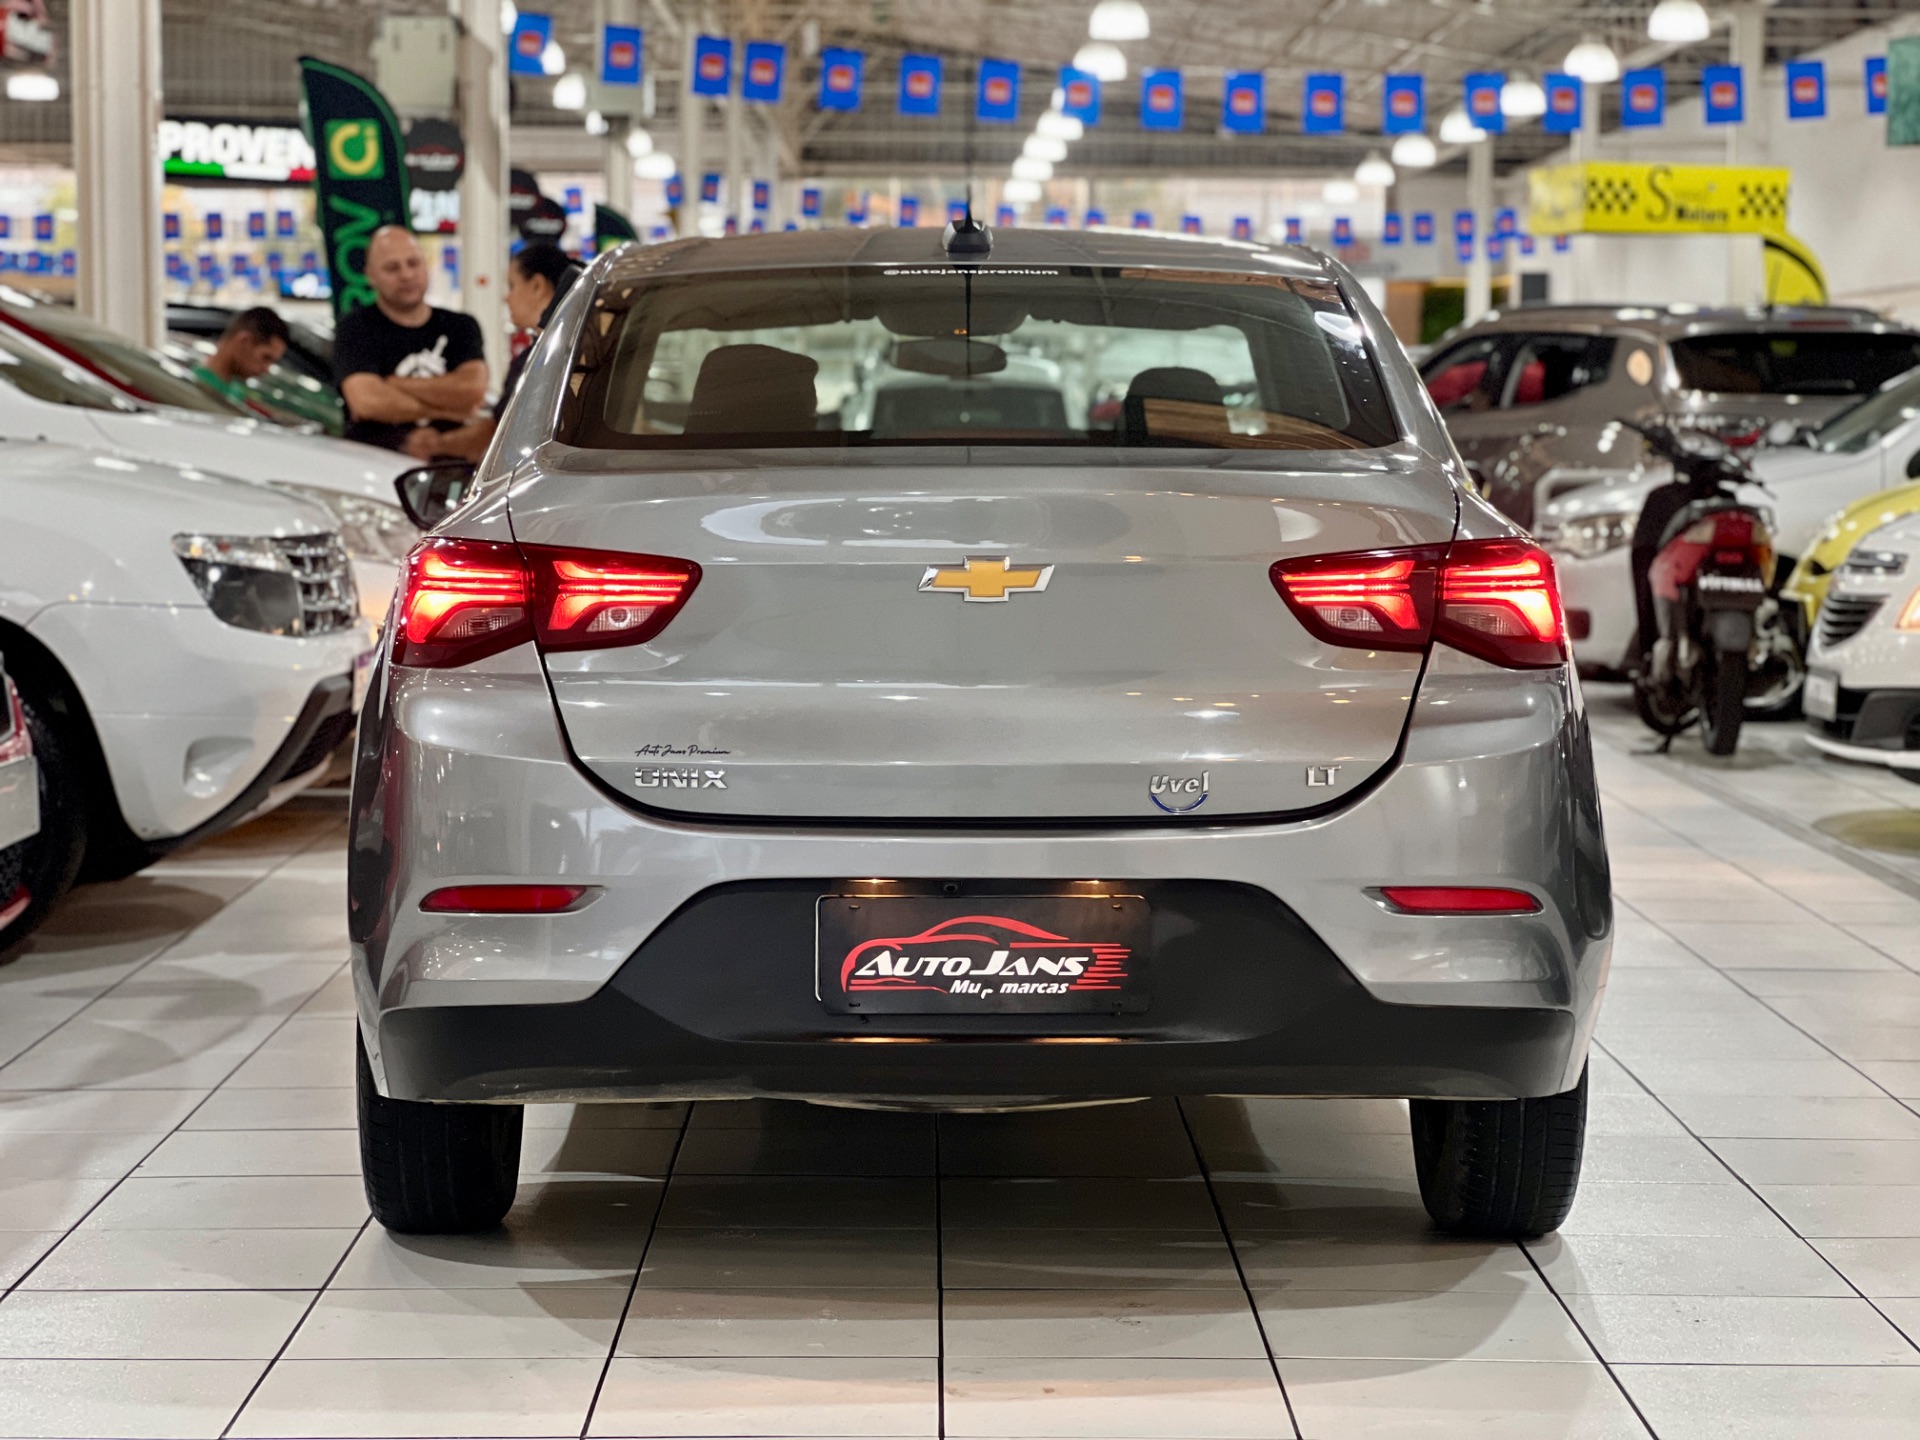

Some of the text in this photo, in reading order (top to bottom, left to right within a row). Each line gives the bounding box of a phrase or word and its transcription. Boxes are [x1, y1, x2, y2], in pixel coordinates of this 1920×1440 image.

[634, 767, 728, 789] ONIX
[1150, 770, 1210, 795] Uvel
[1306, 765, 1342, 787] LT
[1000, 982, 1070, 994] marcas
